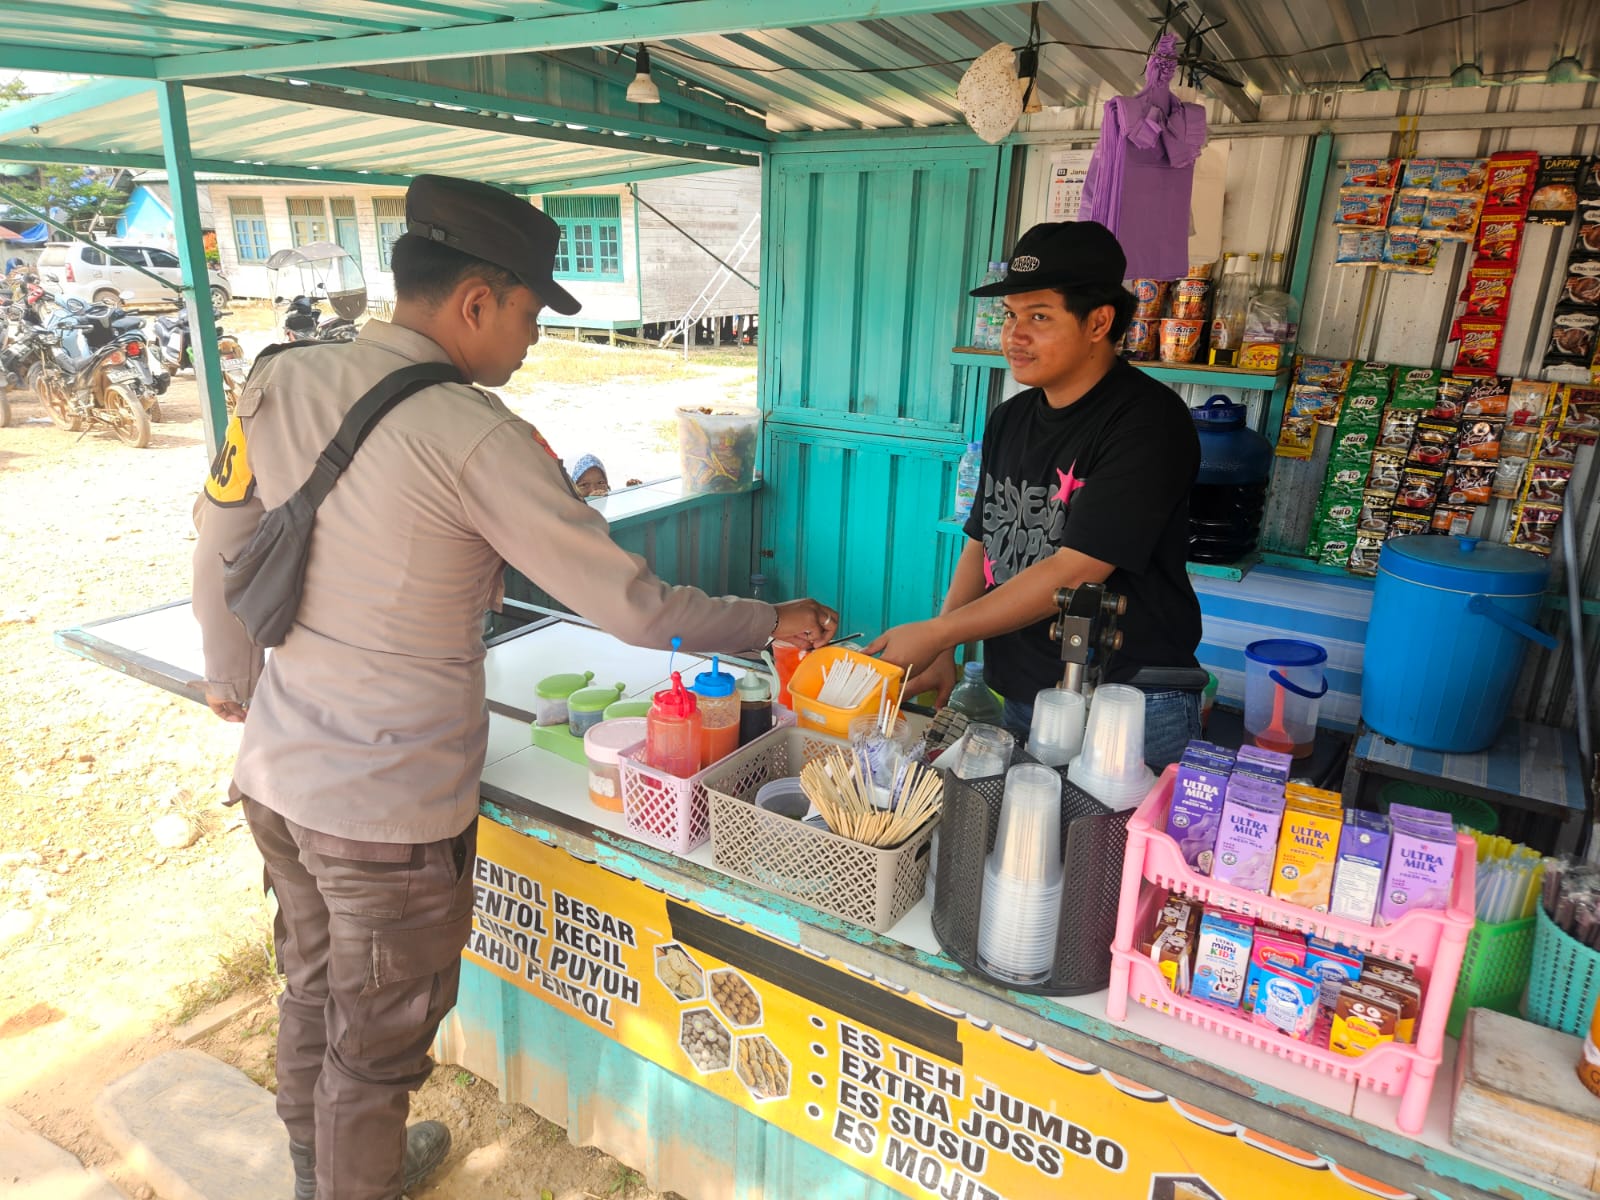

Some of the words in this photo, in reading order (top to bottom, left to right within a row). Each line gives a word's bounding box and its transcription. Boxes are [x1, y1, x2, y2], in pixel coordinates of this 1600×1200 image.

[1408, 371, 1431, 379] MILO
[1353, 398, 1377, 406] MILO
[1183, 779, 1218, 795] ULTRA
[1185, 788, 1213, 802] MILK
[1231, 815, 1268, 832] ULTRA
[1233, 825, 1263, 839] MILK
[1291, 825, 1330, 841] ULTRA
[1294, 835, 1324, 849] MILK
[1400, 848, 1443, 865] ULTRA
[1403, 858, 1436, 872] MILK
[476, 857, 546, 907] ENTOL
[554, 890, 636, 947] BESAR
[473, 885, 547, 935] ENTOL
[555, 918, 627, 970] KECIL
[1210, 948, 1235, 960] KIDS
[1212, 942, 1236, 954] mimi
[473, 913, 541, 964] ENTOL
[550, 945, 640, 1006] PUYUH
[466, 930, 519, 972] TAHU
[527, 962, 613, 1027] PENTOL
[840, 1023, 881, 1060] ES
[892, 1046, 962, 1098] TEH
[975, 1087, 1124, 1172] JUMBO
[841, 1050, 950, 1124] EXTRA
[961, 1110, 1061, 1177] JOSS
[834, 1112, 876, 1153] ES
[840, 1081, 880, 1120] ES
[891, 1106, 986, 1174] SUSU
